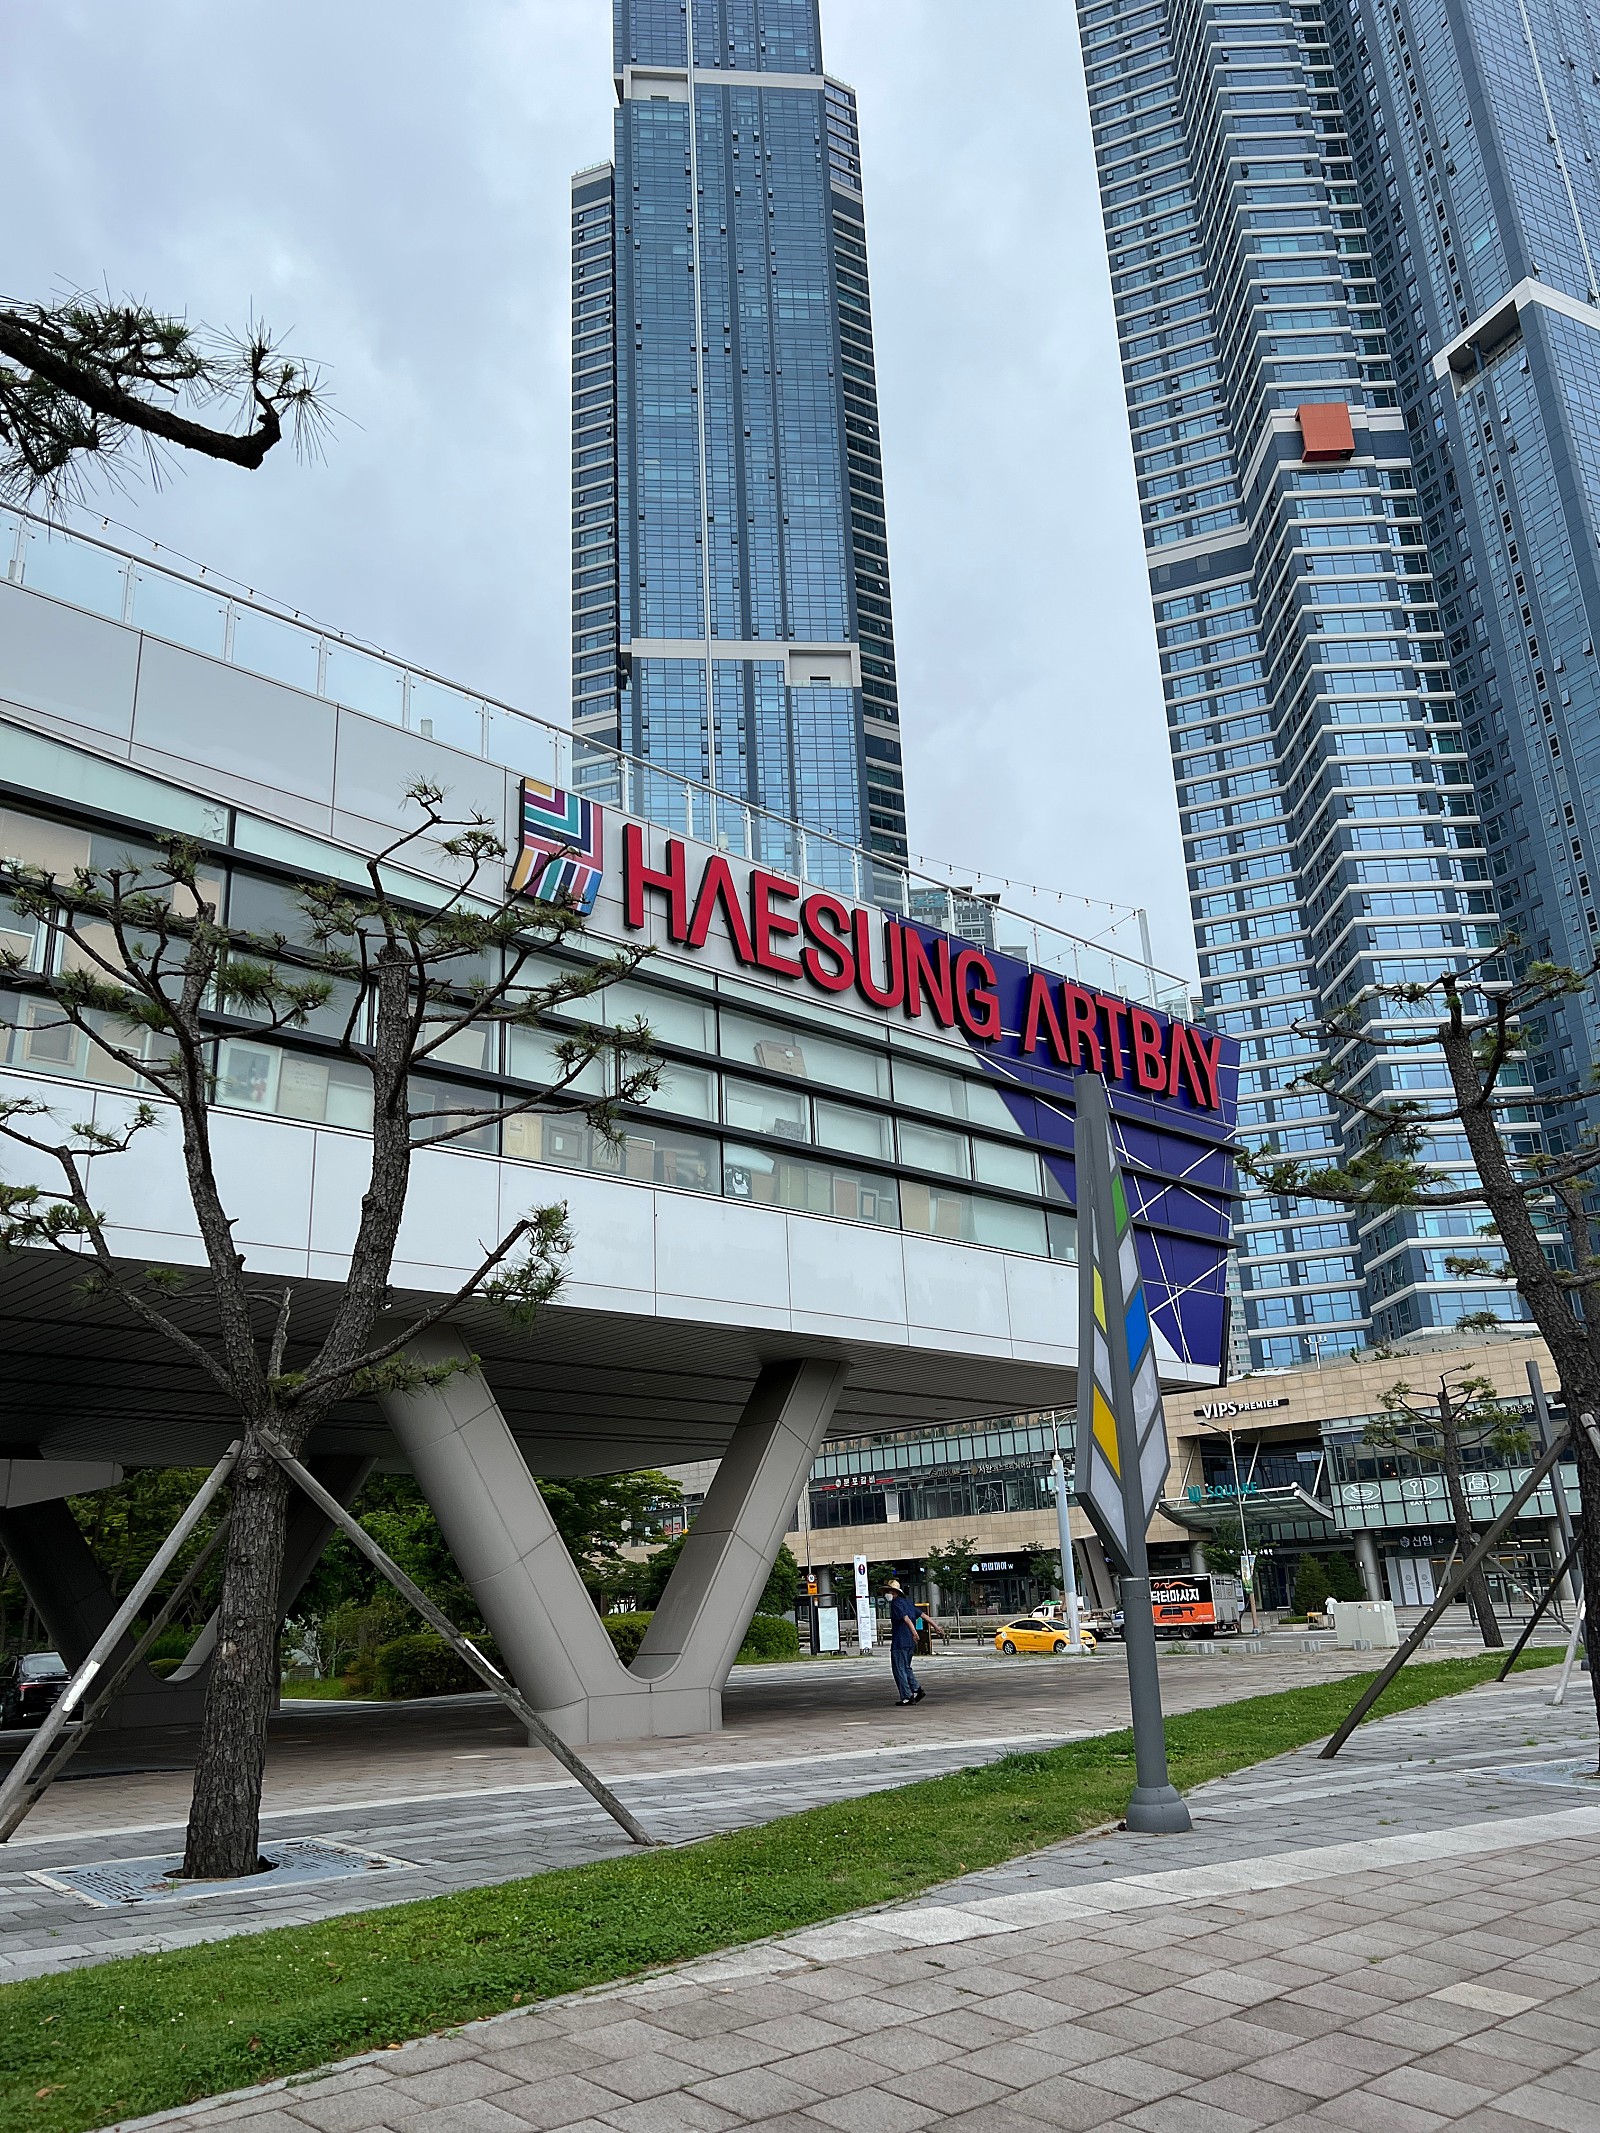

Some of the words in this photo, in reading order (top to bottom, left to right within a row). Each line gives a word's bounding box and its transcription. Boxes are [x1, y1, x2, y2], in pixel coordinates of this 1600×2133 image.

[622, 822, 1002, 1042] HAESUNG
[1021, 972, 1222, 1111] ARTBAY
[1202, 1401, 1237, 1419] VIPS
[1238, 1399, 1279, 1411] PREMIER
[1412, 1534, 1434, 1548] 신협
[1150, 1588, 1200, 1604] 닥터마사지
